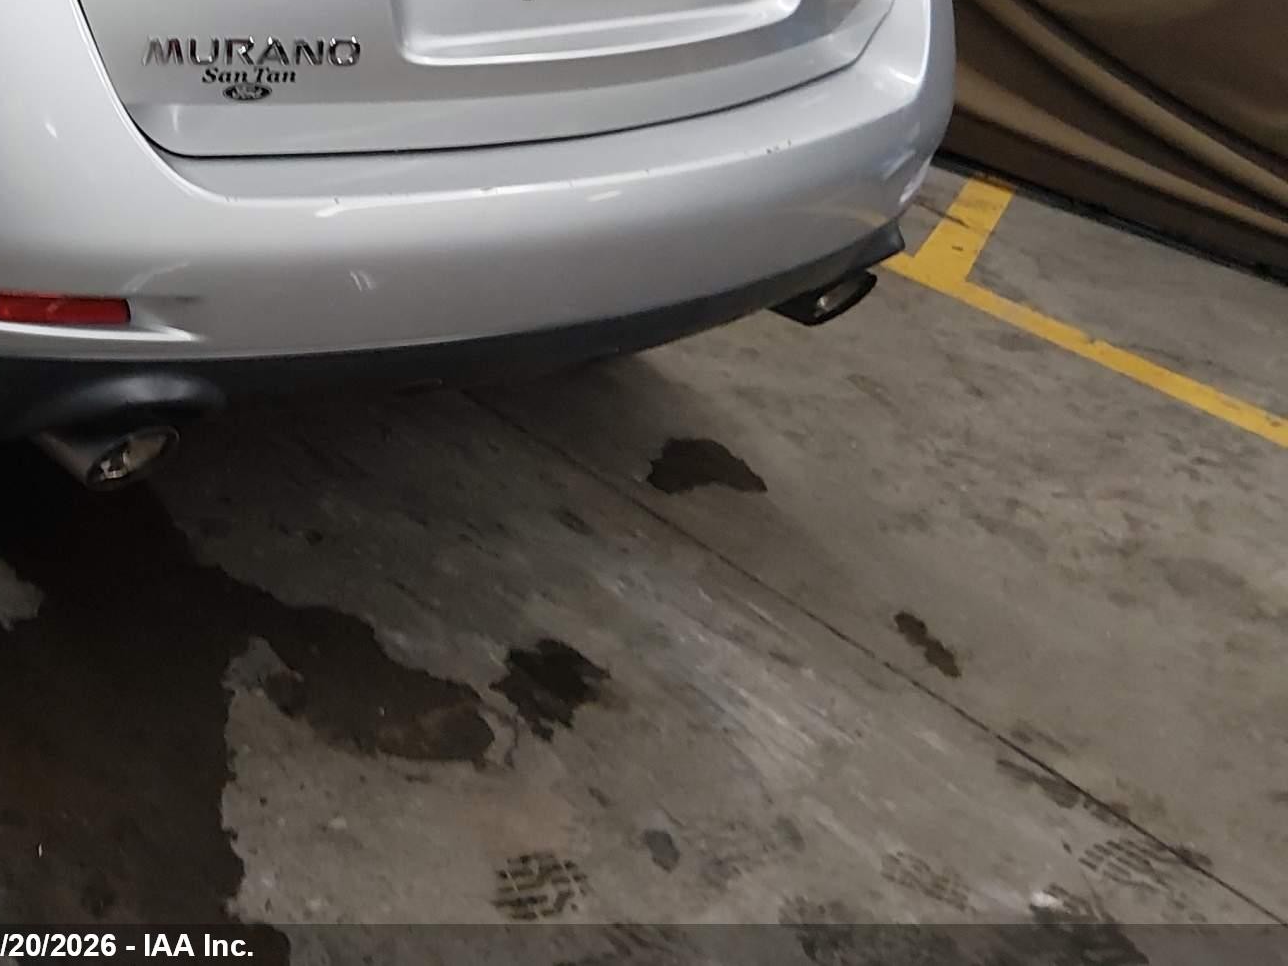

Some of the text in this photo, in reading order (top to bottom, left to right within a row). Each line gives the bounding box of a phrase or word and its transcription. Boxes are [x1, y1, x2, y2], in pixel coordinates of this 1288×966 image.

[141, 35, 361, 67] MURANO
[201, 67, 297, 83] San Tan
